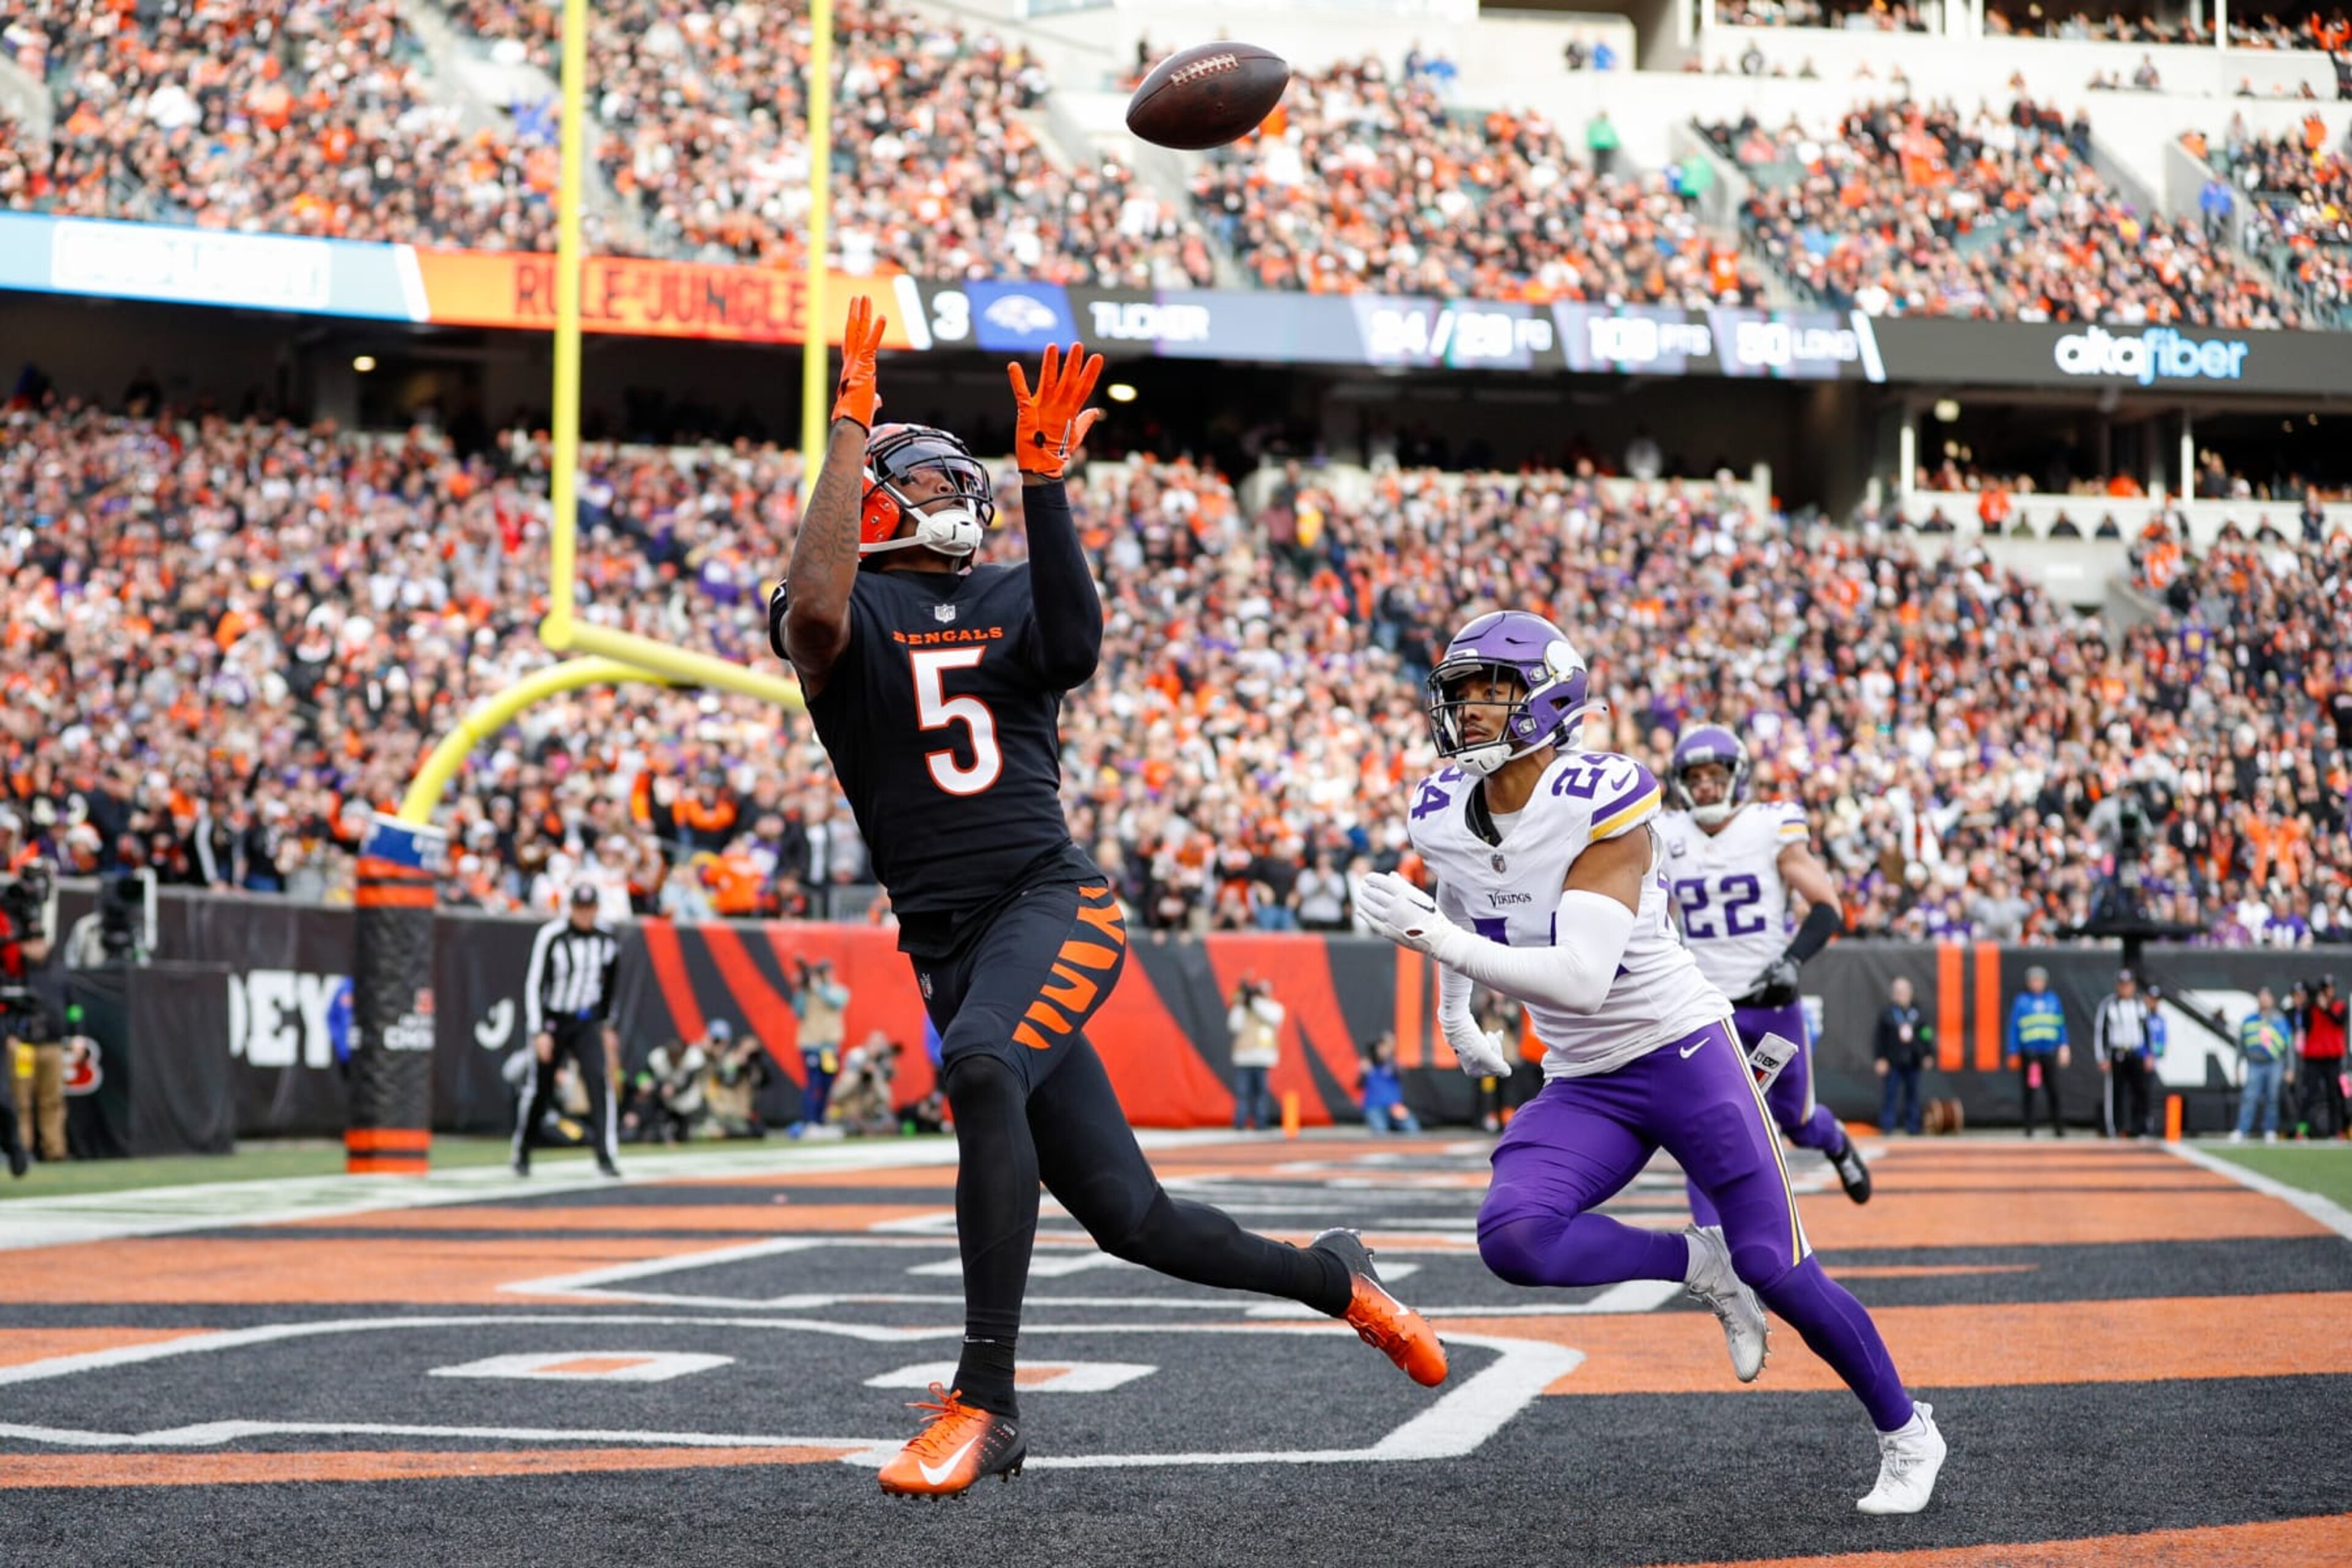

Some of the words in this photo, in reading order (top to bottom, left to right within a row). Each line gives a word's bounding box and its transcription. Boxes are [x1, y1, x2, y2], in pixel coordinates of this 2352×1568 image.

[932, 290, 970, 341] 3
[2054, 325, 2248, 385] altafiber
[892, 627, 1003, 645] BENGALS
[909, 644, 1005, 796] 5
[1674, 873, 1766, 939] 22
